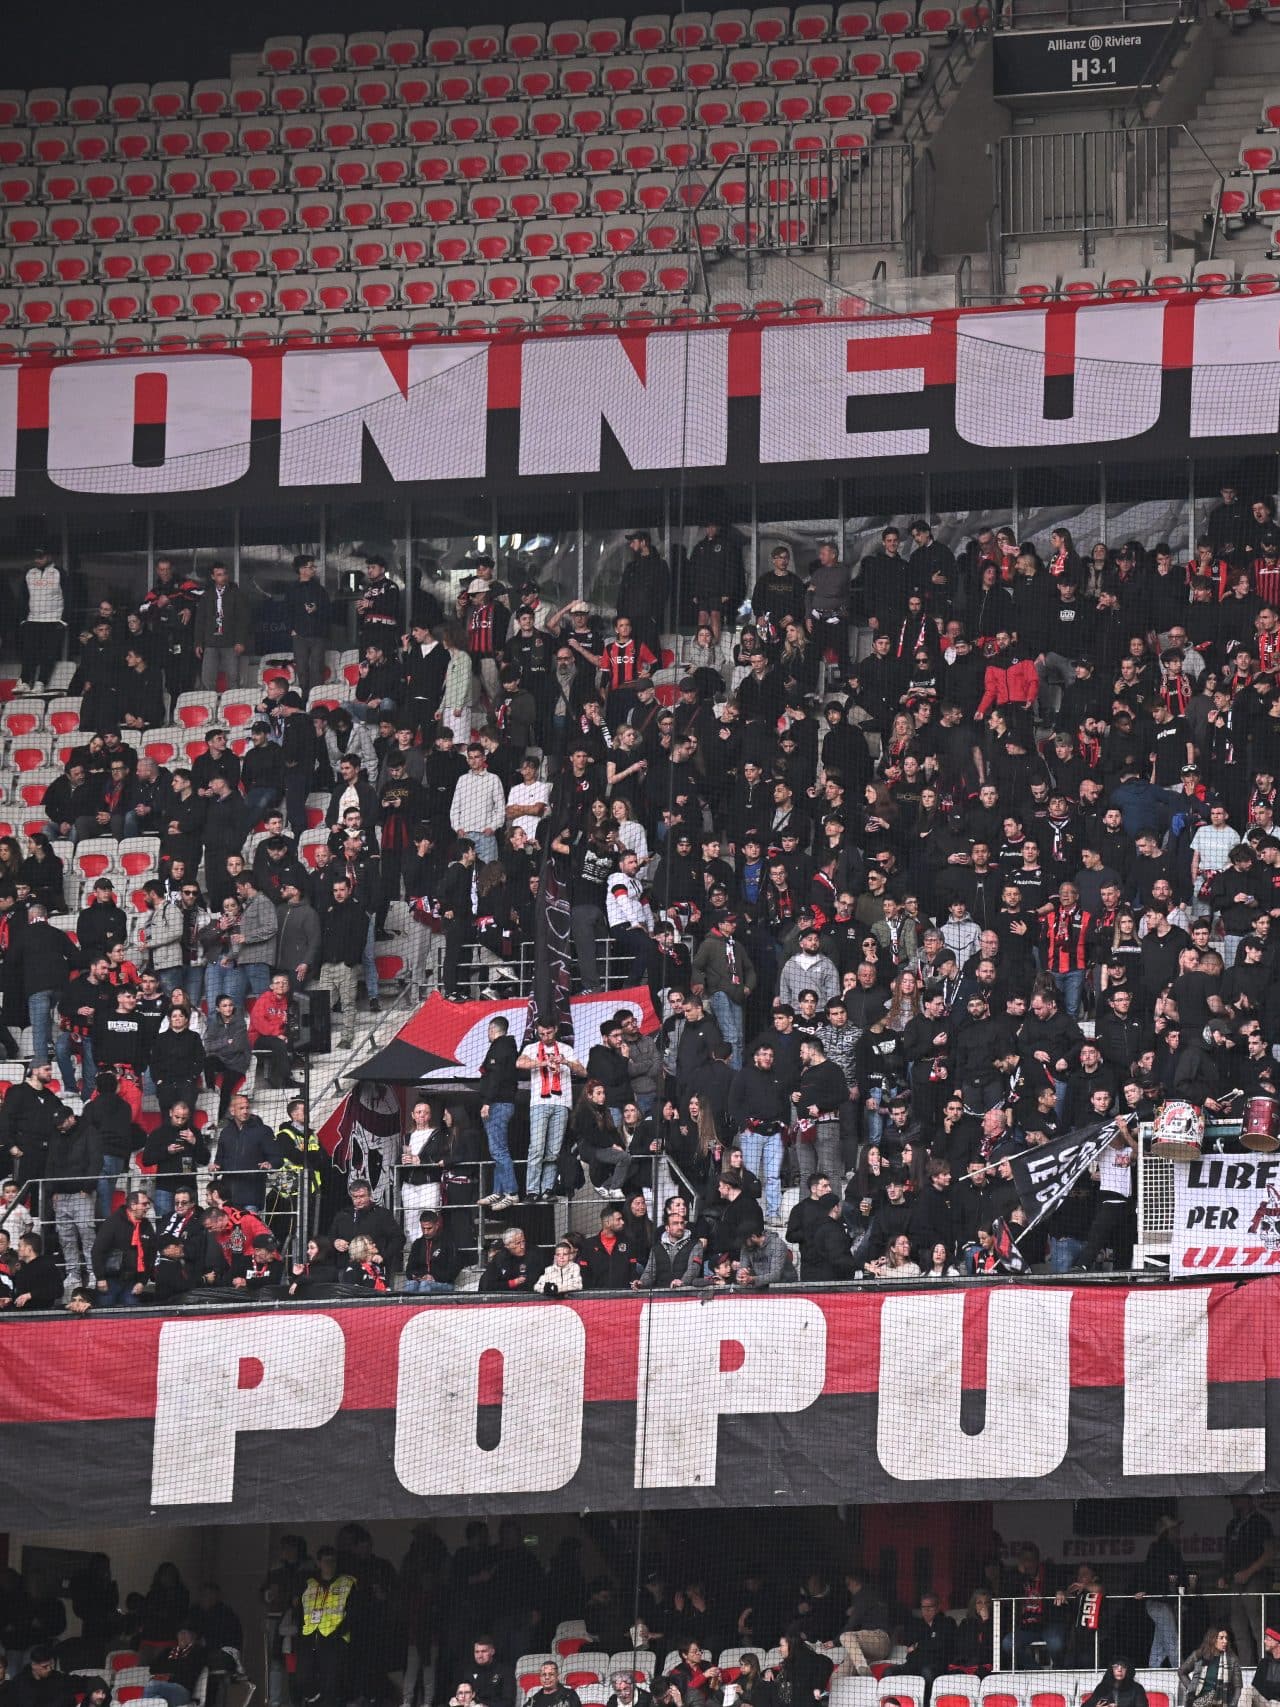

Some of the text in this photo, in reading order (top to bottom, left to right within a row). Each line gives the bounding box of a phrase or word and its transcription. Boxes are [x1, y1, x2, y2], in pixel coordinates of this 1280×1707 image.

[1047, 34, 1142, 51] Allianz Riviera
[1186, 1205, 1239, 1230] PER
[1081, 1592, 1098, 1628] OGC
